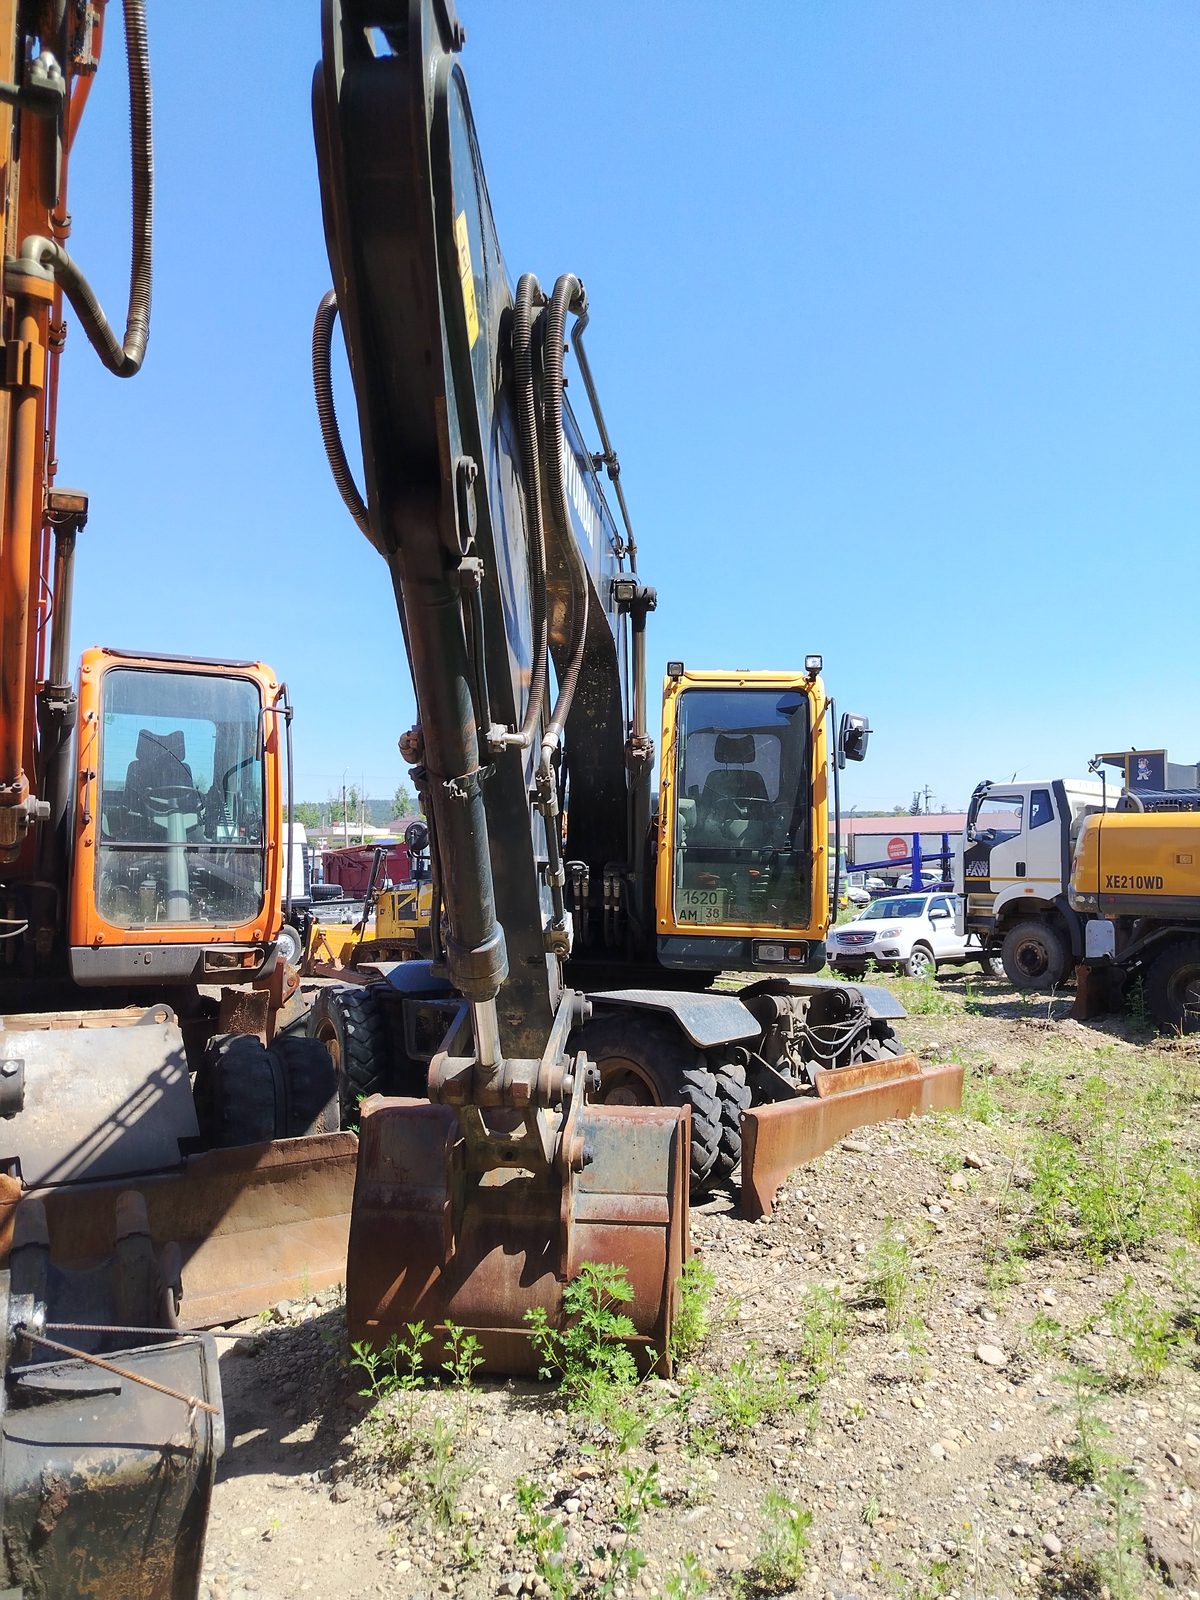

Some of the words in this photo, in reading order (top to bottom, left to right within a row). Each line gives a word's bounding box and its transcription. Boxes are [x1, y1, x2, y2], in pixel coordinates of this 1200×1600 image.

[1105, 875, 1164, 890] XE210WD
[683, 891, 718, 905] 1620
[679, 909, 698, 921] AM
[705, 907, 720, 919] 38
